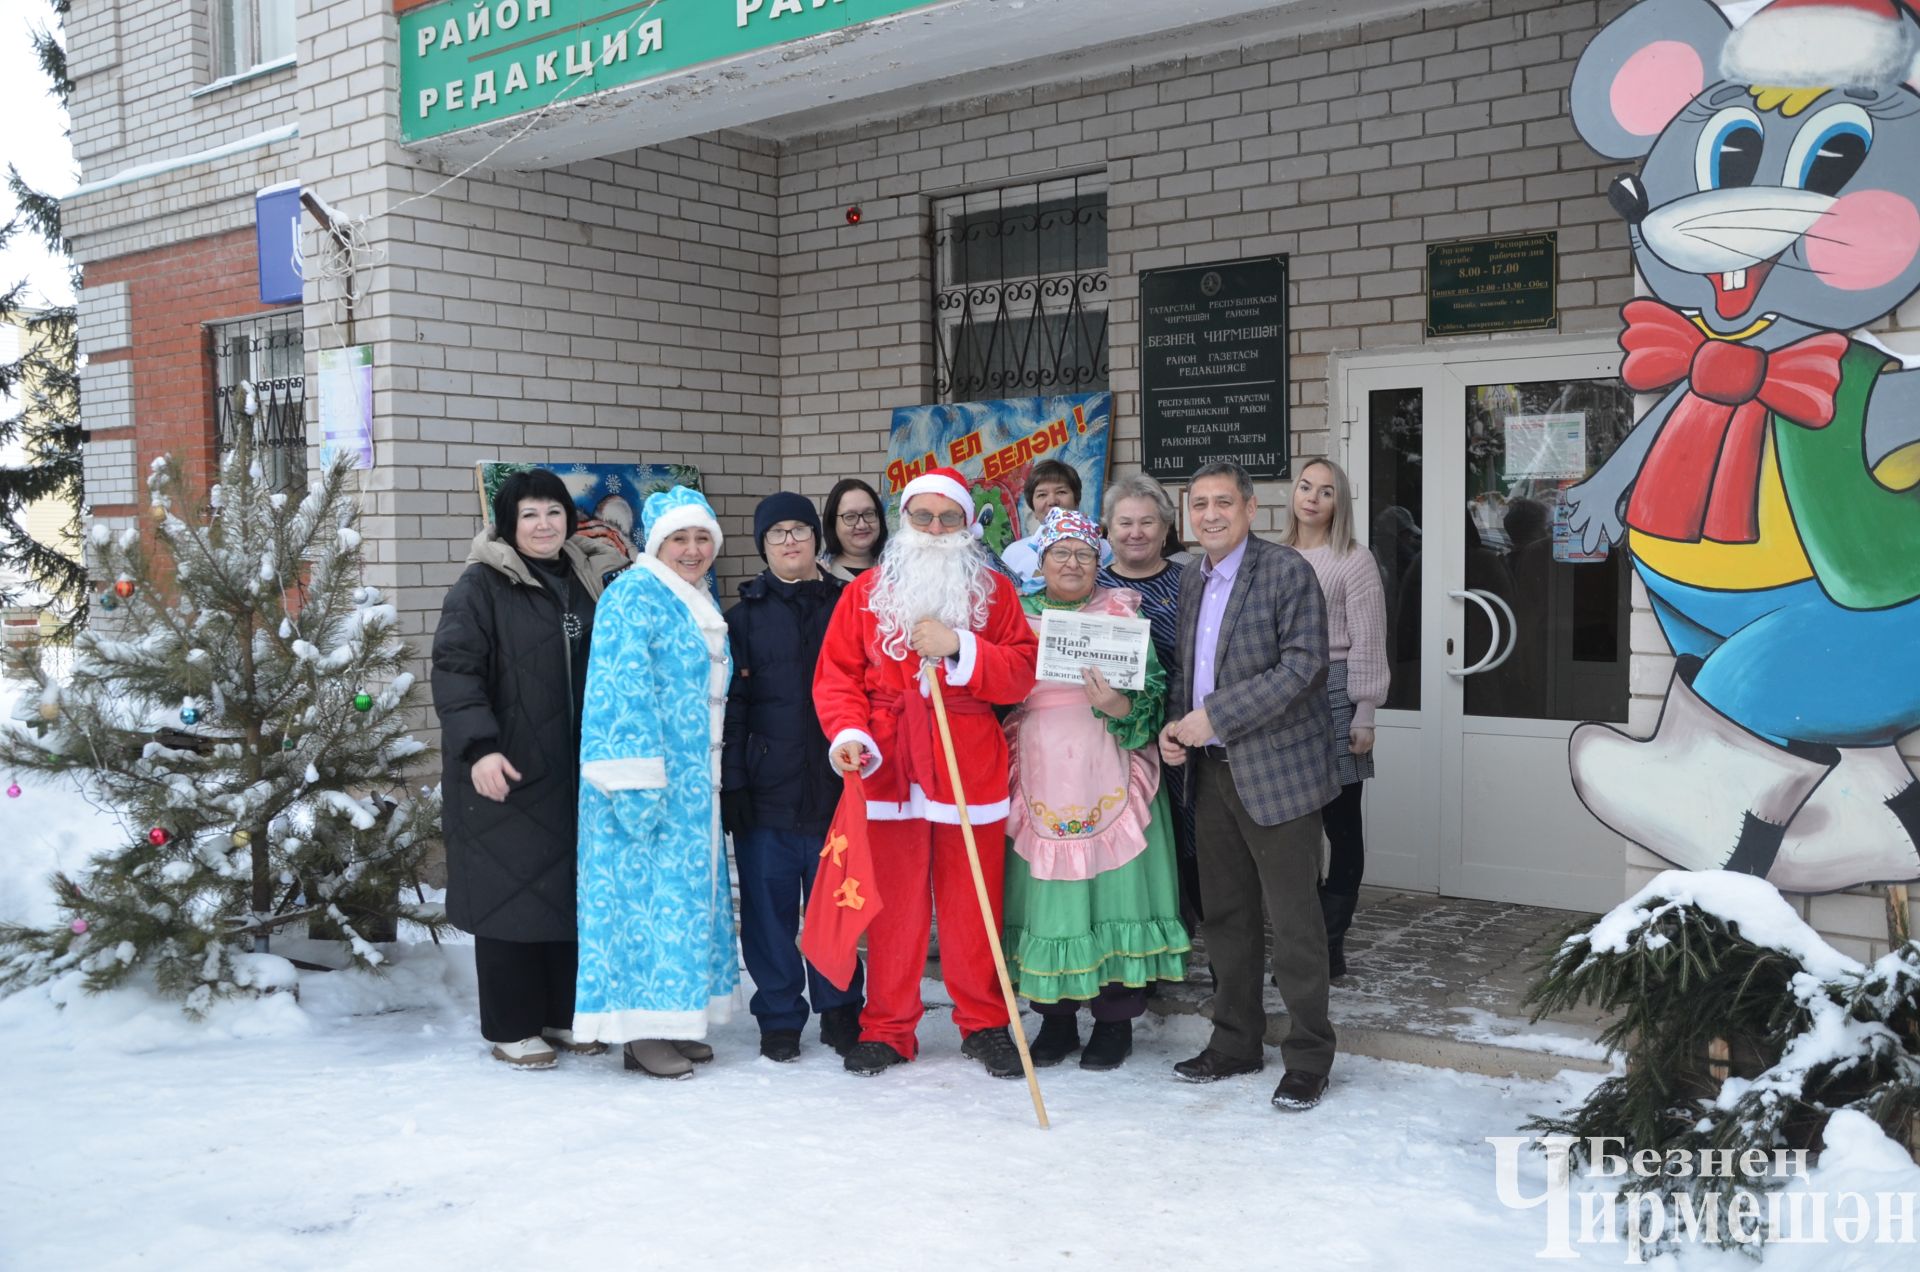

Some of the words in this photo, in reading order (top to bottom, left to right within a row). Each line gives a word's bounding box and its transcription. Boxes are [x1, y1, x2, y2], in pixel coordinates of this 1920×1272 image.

[417, 0, 551, 57] РАЙОН
[419, 18, 662, 118] РЕДАКЦИЯ
[1459, 267, 1481, 278] 8.00
[1491, 263, 1519, 275] 17.00
[1149, 303, 1196, 315] ТАТАРСТАН
[1209, 295, 1278, 309] РЕСПУБЛИКАСЫ
[1208, 349, 1259, 362] ГАЗЕТАСЫ
[1179, 363, 1247, 377] РЕДАКЦИЯСЕ
[1157, 397, 1212, 407] РЕСПУБЛИКА
[1224, 393, 1270, 404] ТАТАРСТАН
[1161, 407, 1229, 418] ЧЕРЕМШАНСКИЙ
[1239, 405, 1267, 414] РАЙОН
[1186, 422, 1241, 434] РЕДАКЦИЯ
[1161, 436, 1211, 447] РАЙОННОЙ
[1228, 433, 1267, 445] ГАЗЕТЫ
[948, 431, 983, 465] ЕЛ
[1057, 646, 1129, 663] Черемшан
